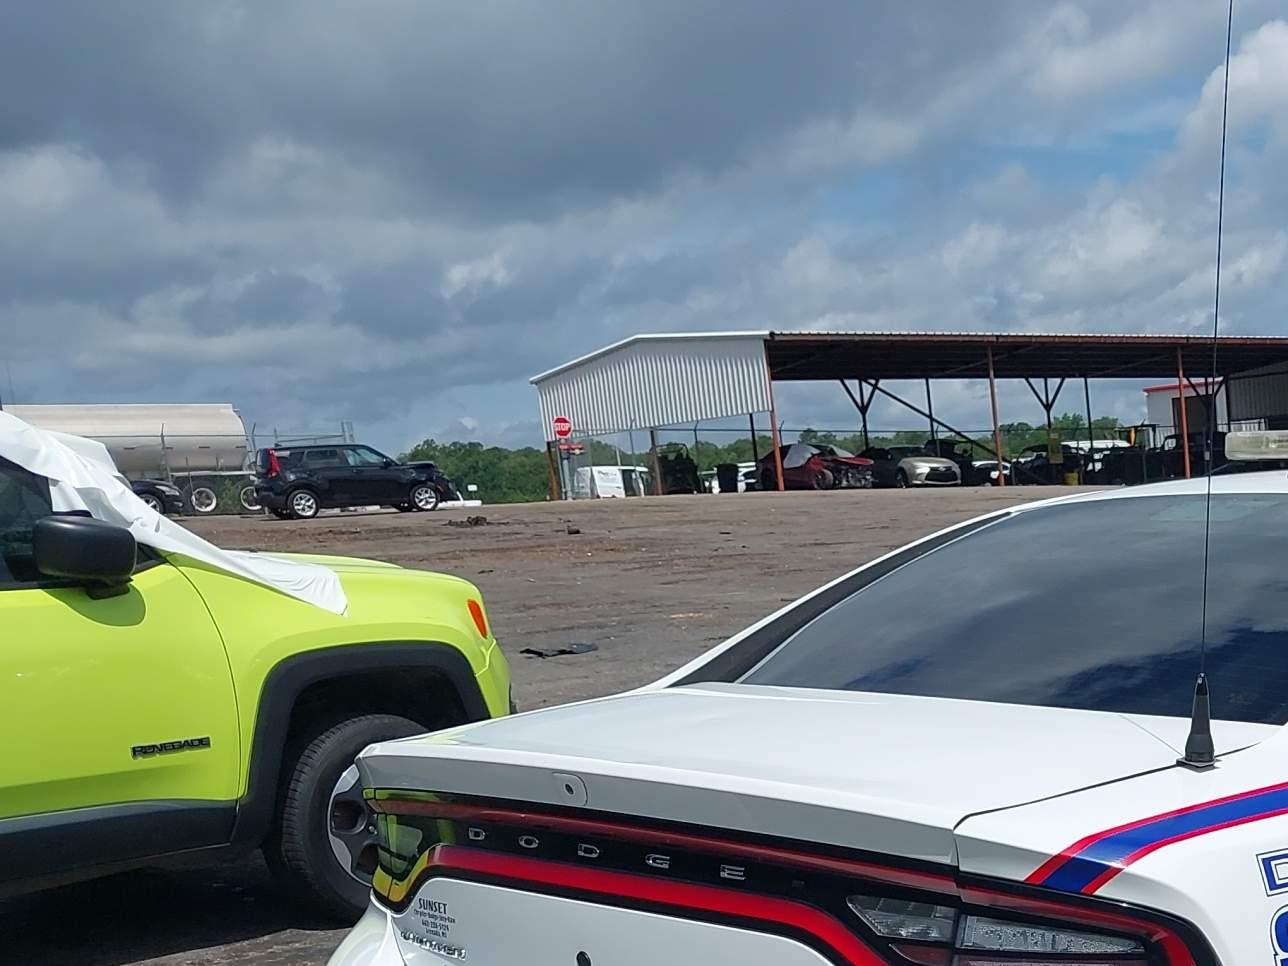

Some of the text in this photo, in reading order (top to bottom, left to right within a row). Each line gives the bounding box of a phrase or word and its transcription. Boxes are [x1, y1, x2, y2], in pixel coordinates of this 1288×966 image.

[554, 422, 570, 432] STOP
[132, 736, 211, 760] RENEGADE
[468, 827, 746, 881] DODGE
[418, 897, 447, 914] SUNSET
